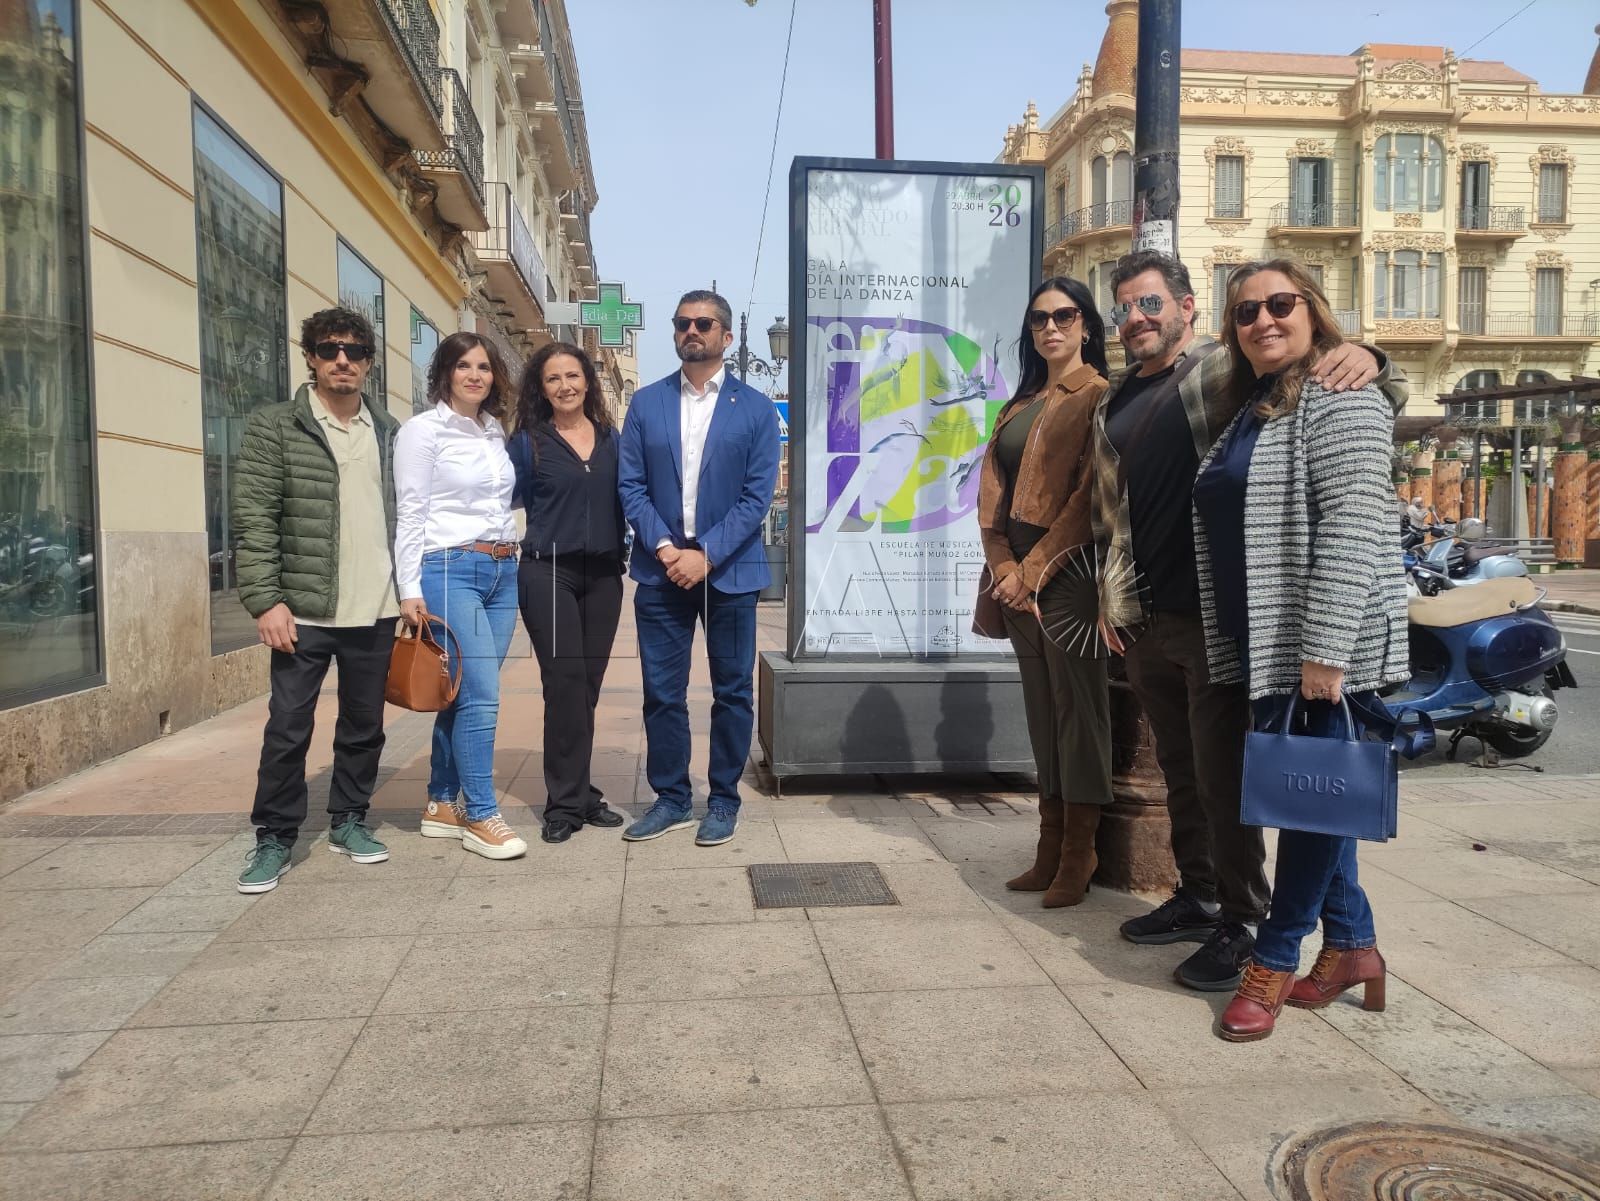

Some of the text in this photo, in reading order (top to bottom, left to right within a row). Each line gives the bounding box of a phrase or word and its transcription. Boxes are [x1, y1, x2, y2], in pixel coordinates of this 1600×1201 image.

[987, 184, 1022, 206] 20
[987, 204, 1021, 228] 26
[807, 259, 848, 272] GALA
[807, 271, 969, 289] DÍA INTERNACIONAL
[807, 287, 914, 301] DE LA DANZA
[880, 541, 920, 549] ESCUELA
[963, 550, 986, 558] GON
[887, 609, 917, 617] HASTA
[1283, 771, 1346, 796] TOUS
